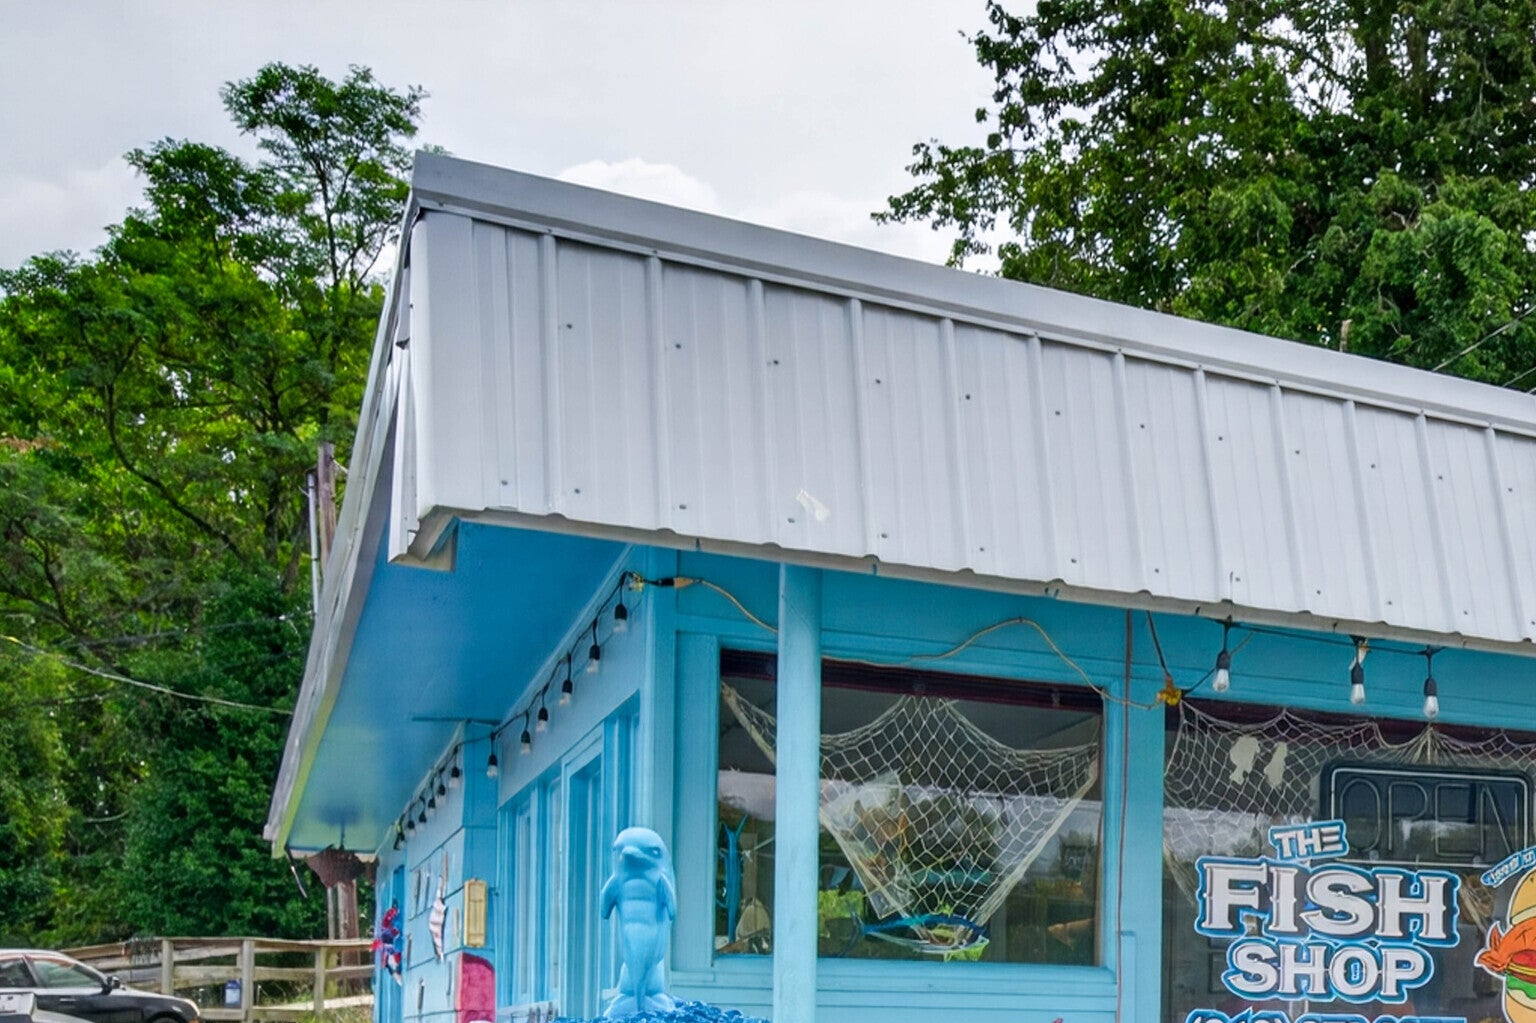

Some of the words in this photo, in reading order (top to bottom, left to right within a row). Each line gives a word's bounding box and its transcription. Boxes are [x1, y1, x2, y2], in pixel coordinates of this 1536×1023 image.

[1273, 826, 1341, 860] THE
[1340, 778, 1518, 857] OPEN
[1200, 863, 1447, 940] FISH
[1227, 942, 1426, 998] SHOP
